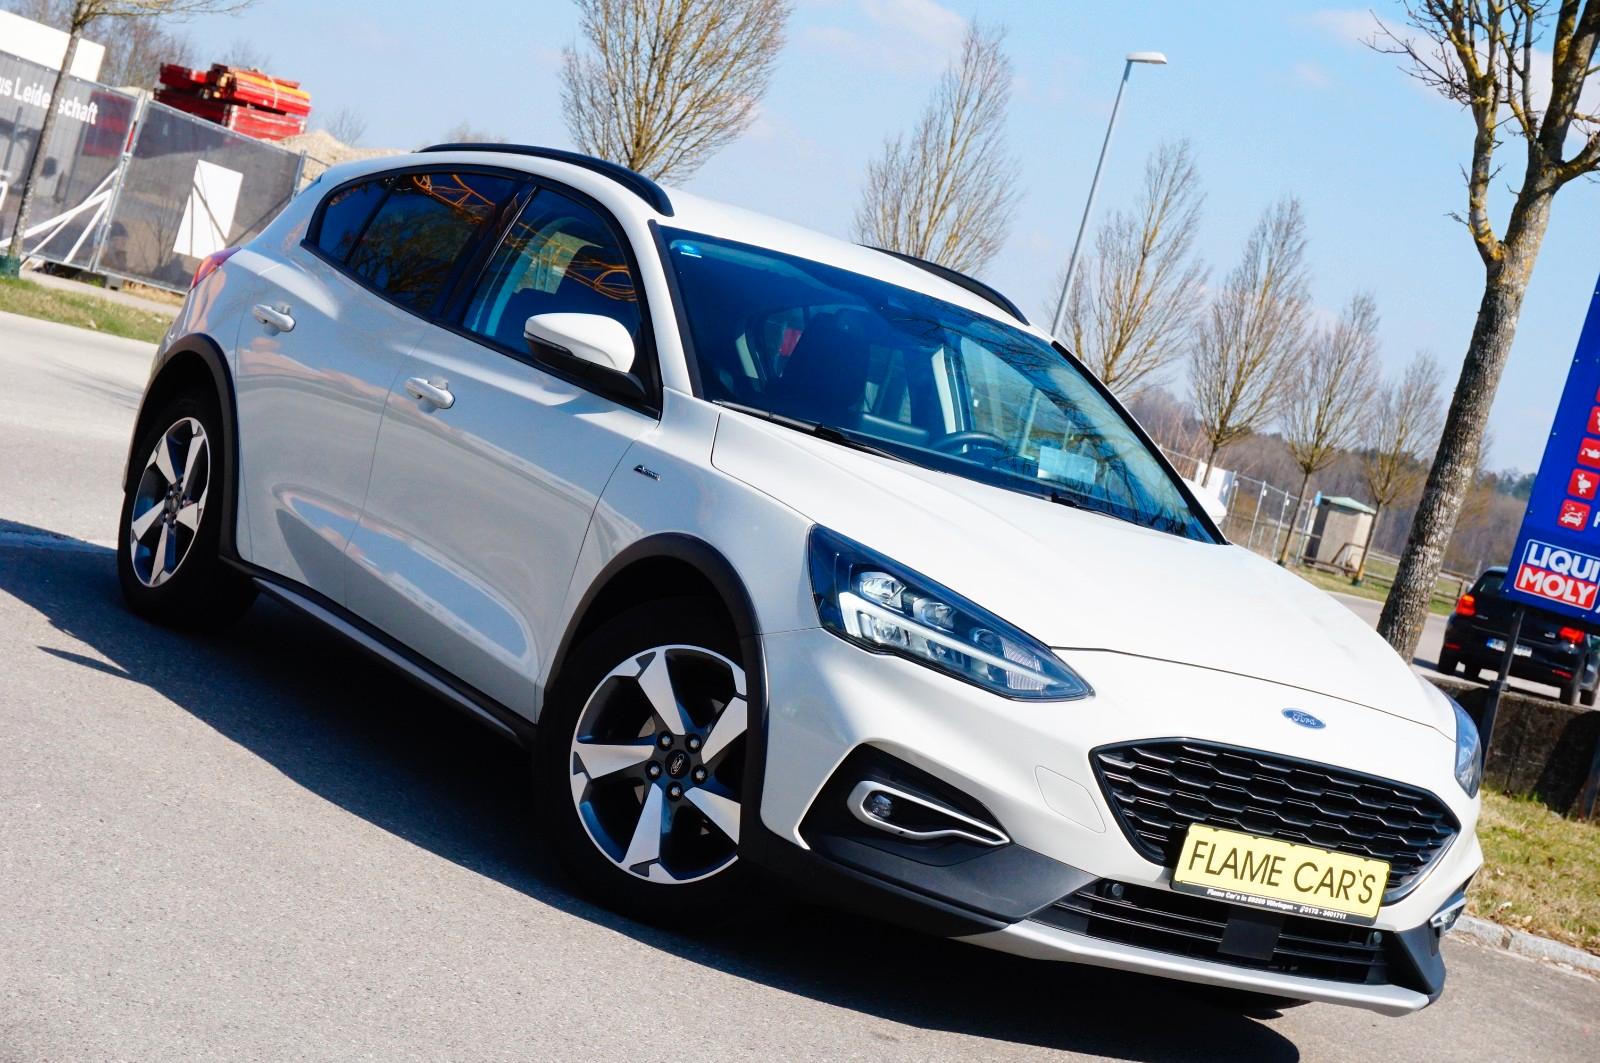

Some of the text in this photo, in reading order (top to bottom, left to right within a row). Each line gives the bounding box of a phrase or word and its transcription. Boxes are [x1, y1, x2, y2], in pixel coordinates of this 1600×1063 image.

[14, 77, 98, 125] Leideschaft
[1527, 543, 1600, 582] LIQUI
[1519, 567, 1596, 605] MOLY
[1188, 840, 1286, 886] FLAME
